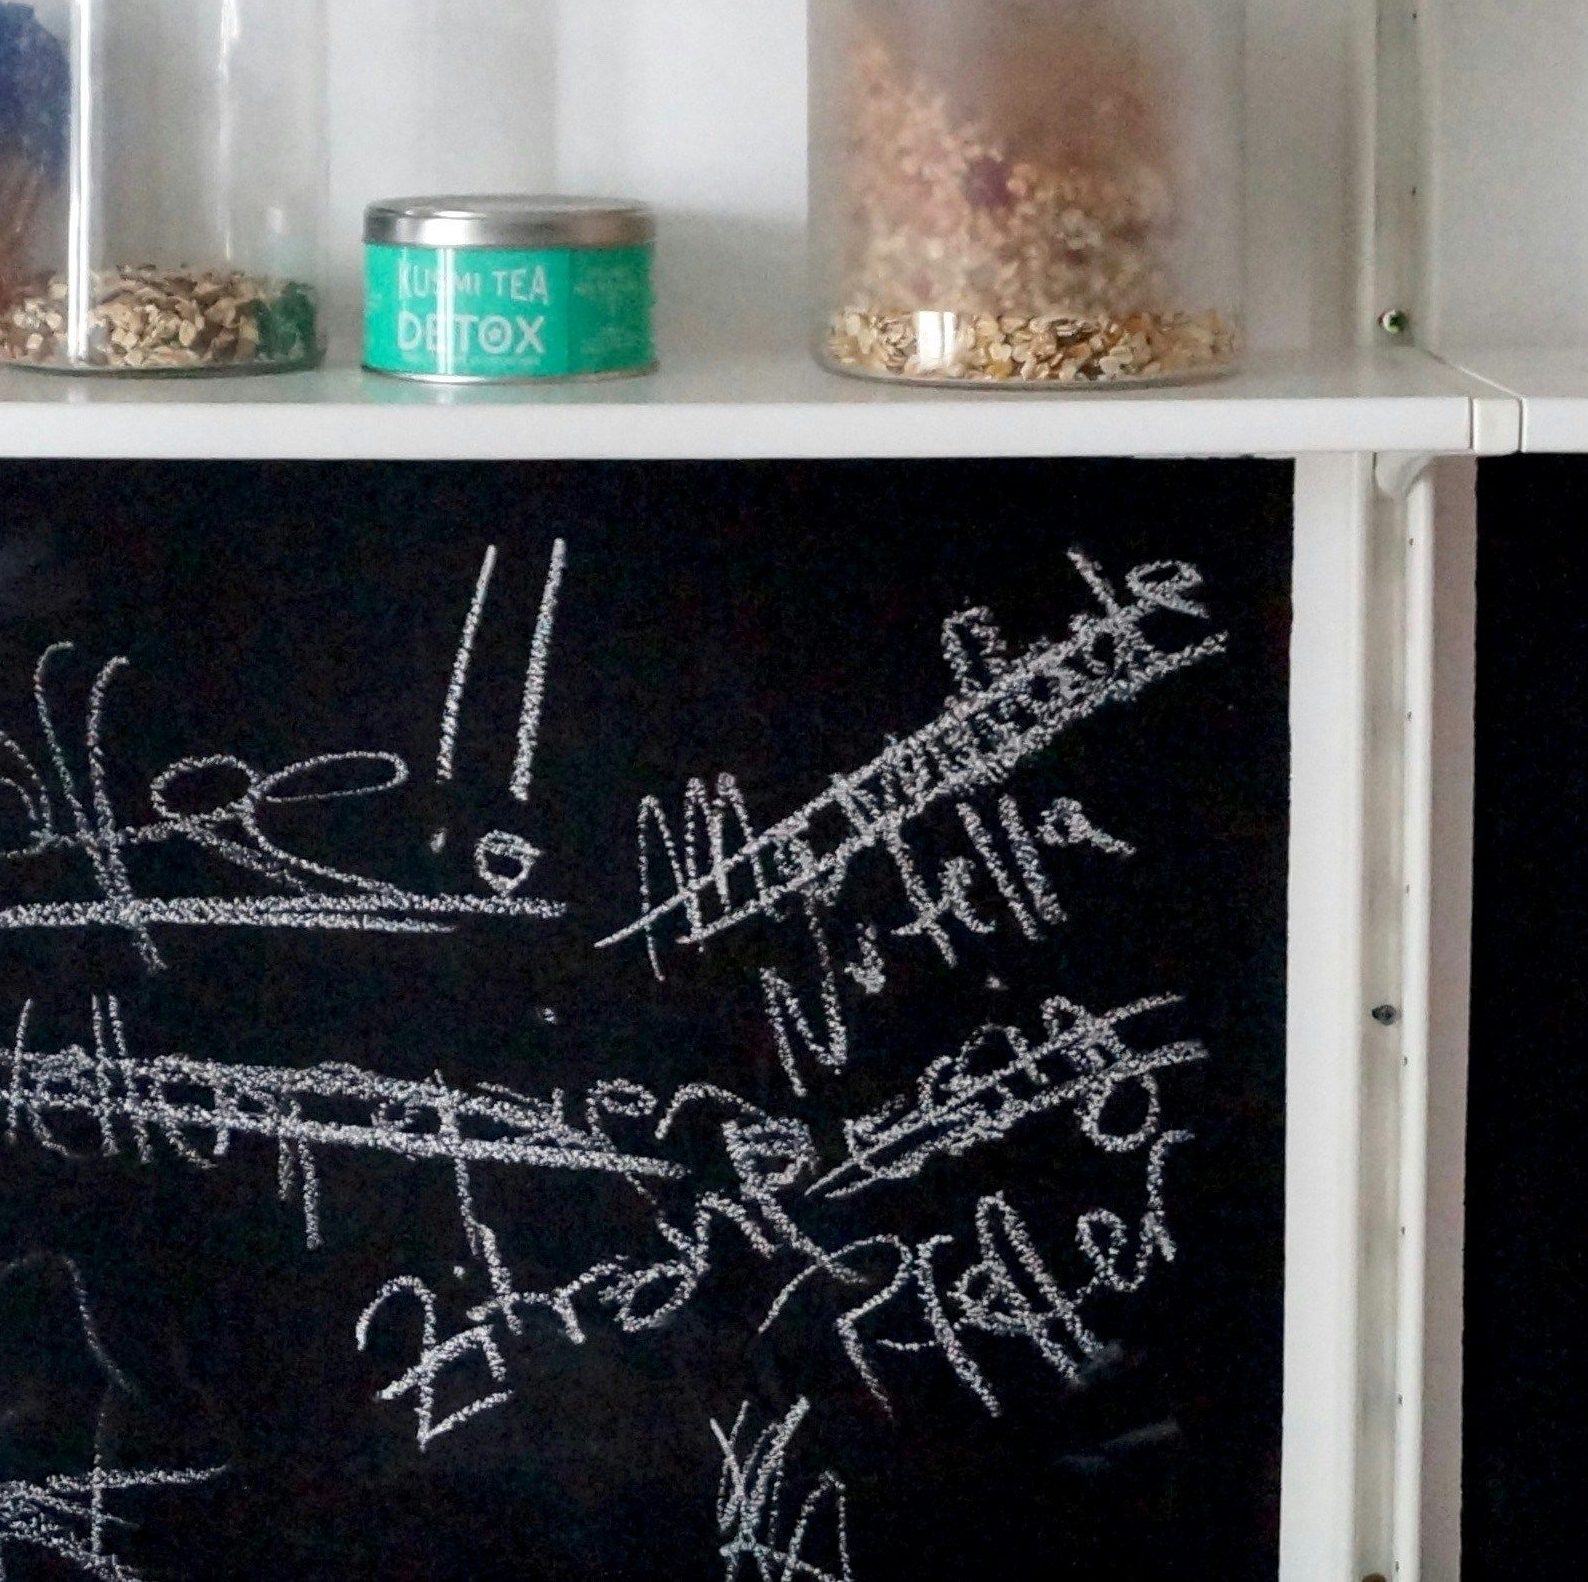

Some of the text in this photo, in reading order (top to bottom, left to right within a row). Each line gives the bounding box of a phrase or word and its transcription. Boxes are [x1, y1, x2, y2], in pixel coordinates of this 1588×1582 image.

[491, 265, 550, 306] TEA
[397, 309, 546, 356] DETOX
[760, 793, 1137, 1097] Nutella
